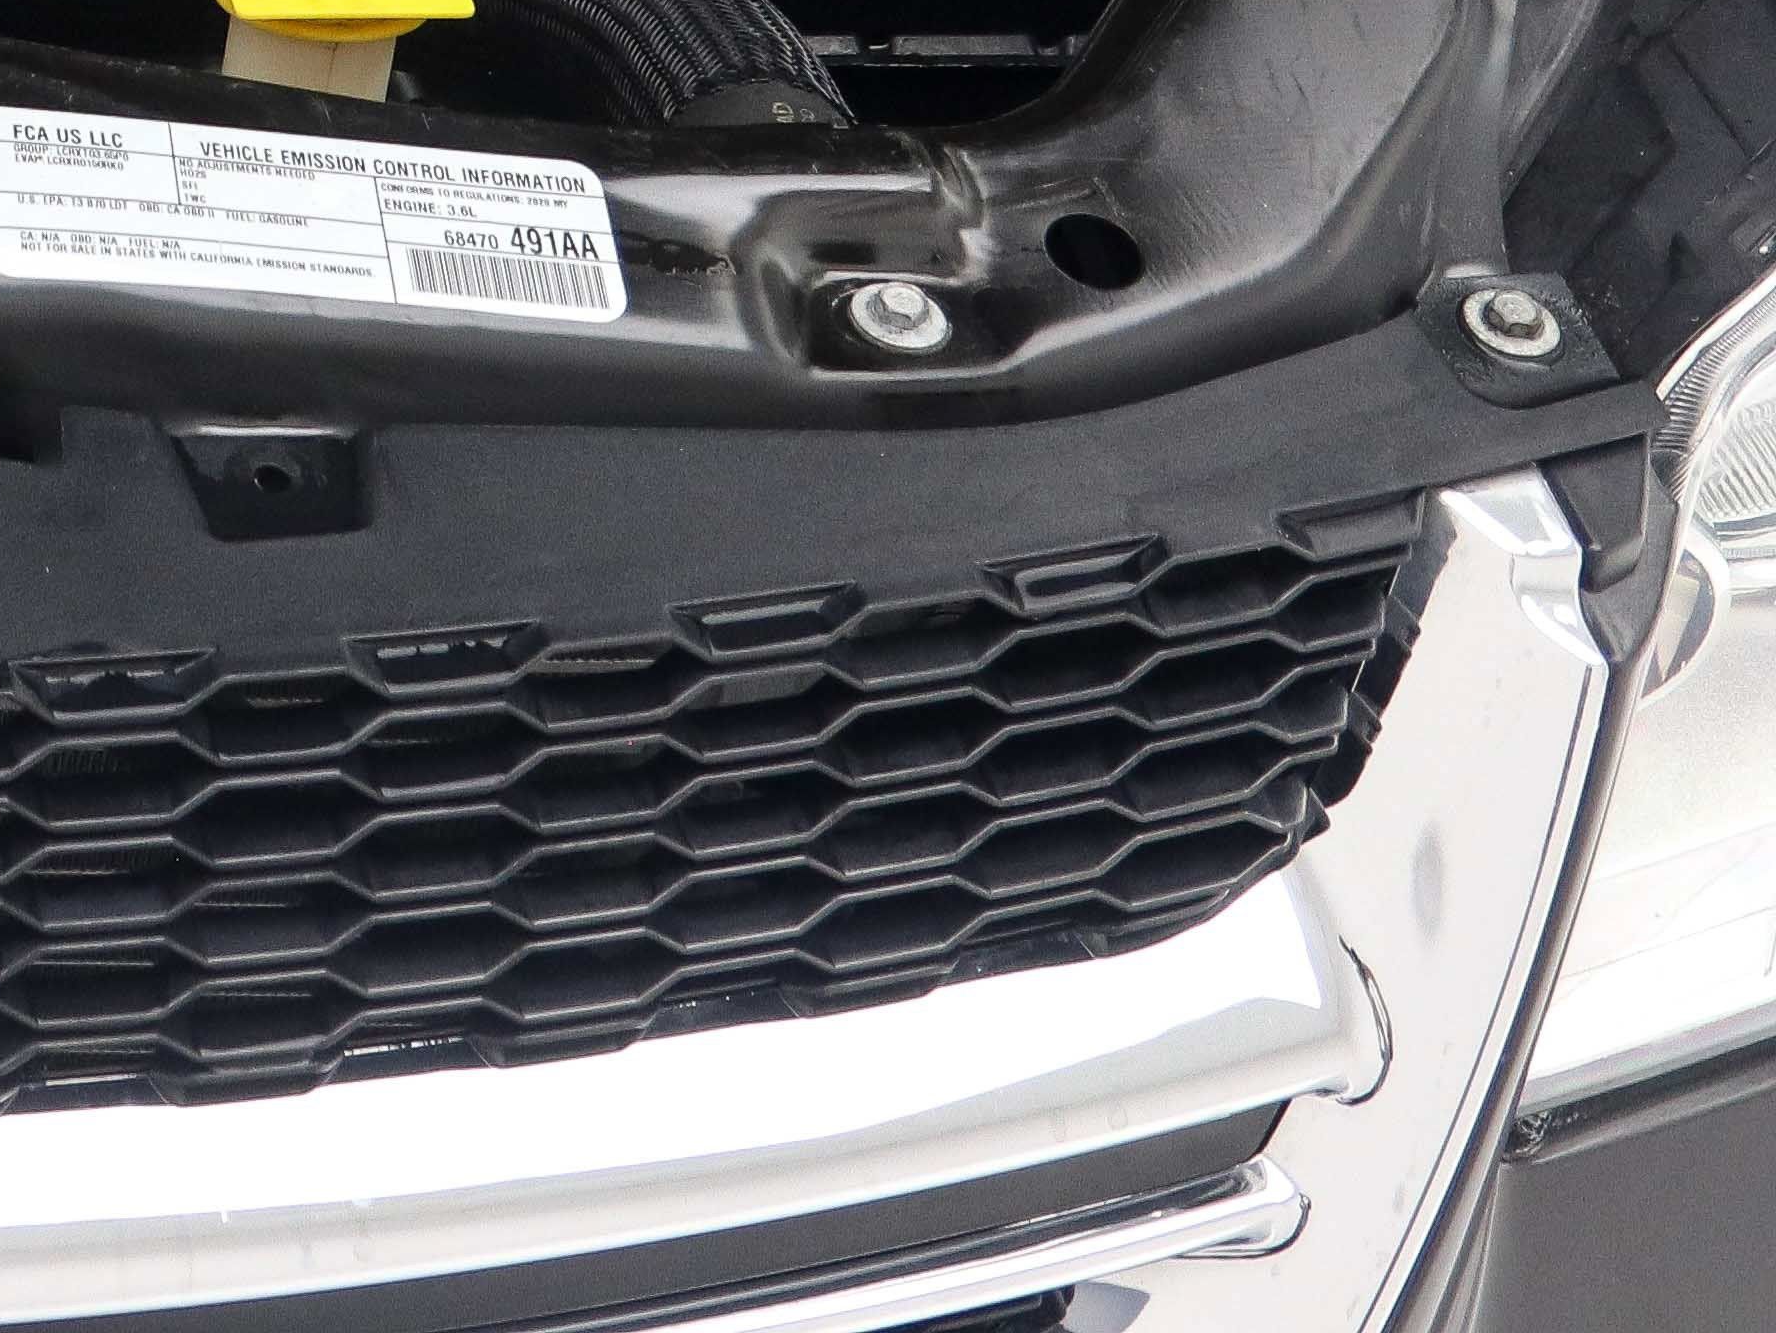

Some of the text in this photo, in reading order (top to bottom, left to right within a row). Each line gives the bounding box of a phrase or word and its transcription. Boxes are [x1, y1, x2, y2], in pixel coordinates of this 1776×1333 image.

[13, 124, 123, 148] FCA US LLC
[200, 141, 586, 193] VEHICLE EMISSION CONTROL INFORMATION
[438, 188, 450, 198] TO
[167, 205, 181, 215] CA
[384, 199, 477, 218] ENGINE: 3.6L
[41, 232, 60, 242] N/A
[99, 235, 118, 245] N/A
[162, 239, 180, 249] N/A
[444, 226, 599, 260] 68470 491AA
[20, 241, 42, 252] NOT
[47, 243, 68, 253] FOR
[71, 245, 98, 255] SALE
[100, 246, 112, 256] IN
[117, 247, 156, 259] STATES
[160, 249, 187, 261] WITH
[190, 252, 253, 267] CALIFORNIA
[256, 259, 306, 271] EMISSION
